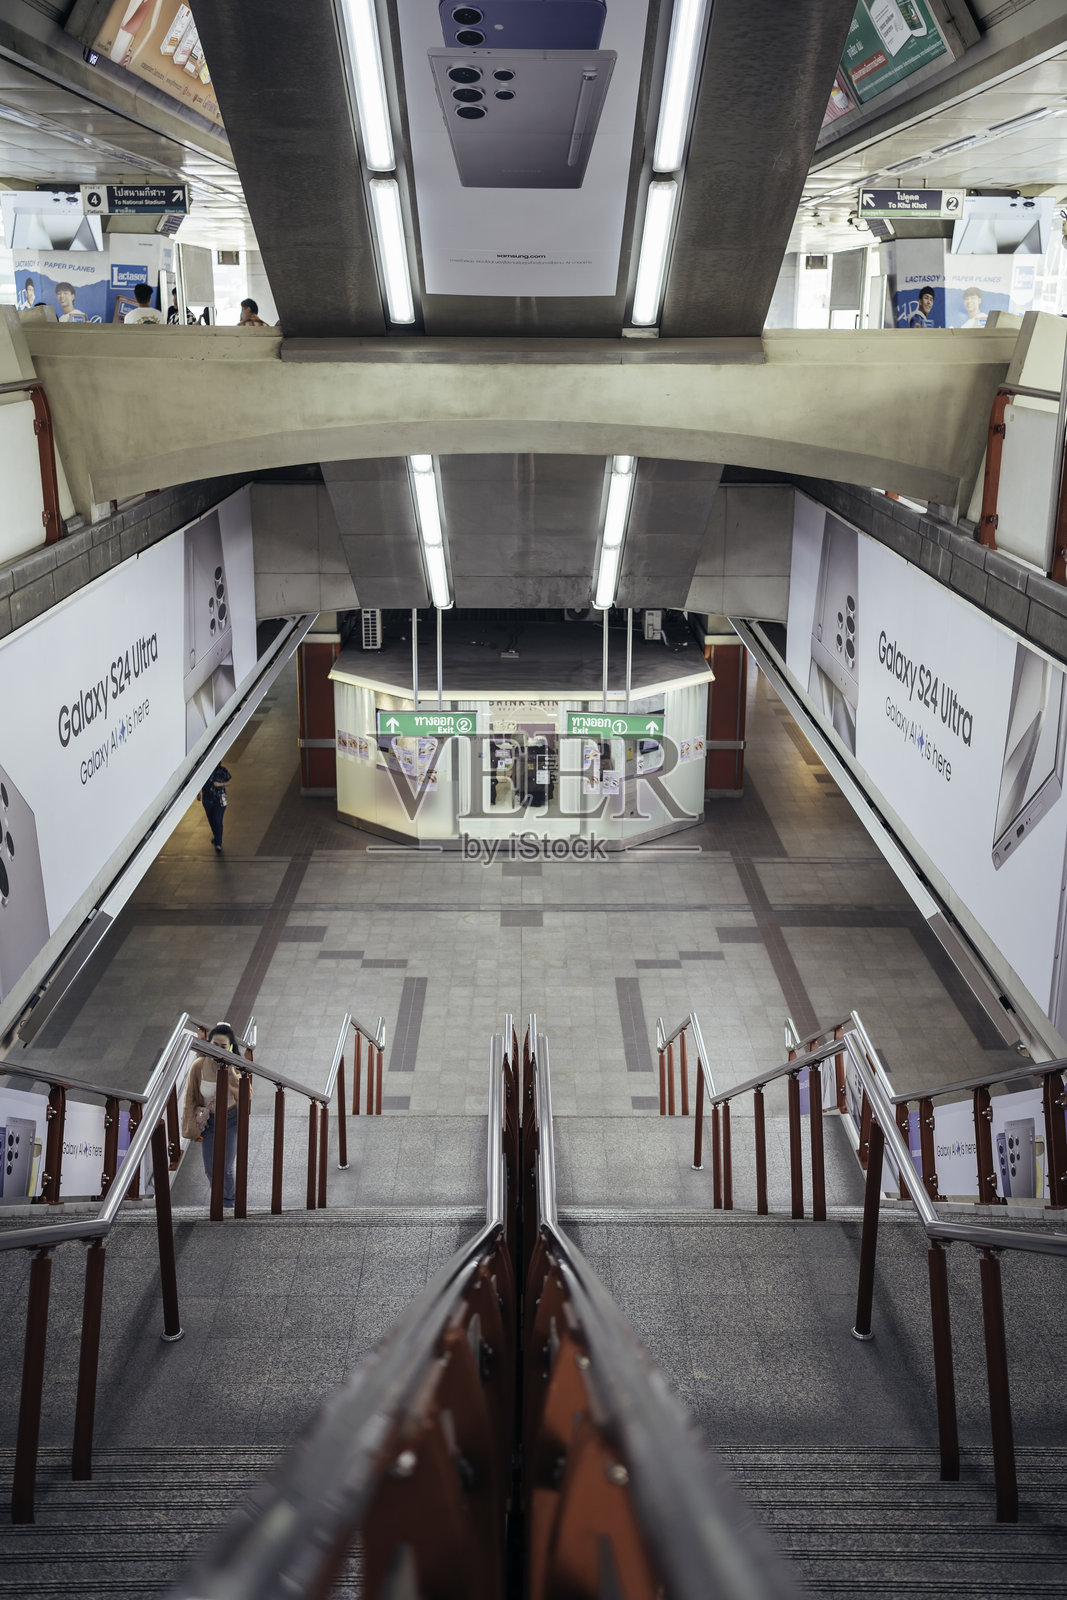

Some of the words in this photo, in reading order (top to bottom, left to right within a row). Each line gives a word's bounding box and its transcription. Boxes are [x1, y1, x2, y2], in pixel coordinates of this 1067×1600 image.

[44, 261, 67, 270] PAPER
[68, 263, 96, 273] PLANES
[112, 266, 147, 286] Lactasoy
[905, 275, 940, 283] LACTASOY
[58, 674, 109, 748] Galaxy
[110, 650, 132, 699] S24
[132, 633, 159, 679] Ultra
[878, 630, 918, 701] Galaxy
[917, 664, 939, 714] S24
[940, 682, 973, 747] Ultra
[414, 716, 455, 727] ทางออก
[437, 726, 454, 734] Exit
[571, 716, 612, 728] ทางออก
[572, 727, 589, 735] Exit
[885, 696, 909, 744] Galaxy
[909, 722, 917, 747] AI
[924, 735, 932, 760] is
[932, 744, 952, 782] here
[80, 739, 109, 785] Galaxy
[110, 727, 118, 753] AI
[125, 714, 133, 736] is
[133, 698, 150, 728] here
[62, 1141, 78, 1159] Galaxy
[92, 1141, 102, 1157] here
[936, 1144, 952, 1160] Galaxy
[965, 1141, 977, 1155] here
